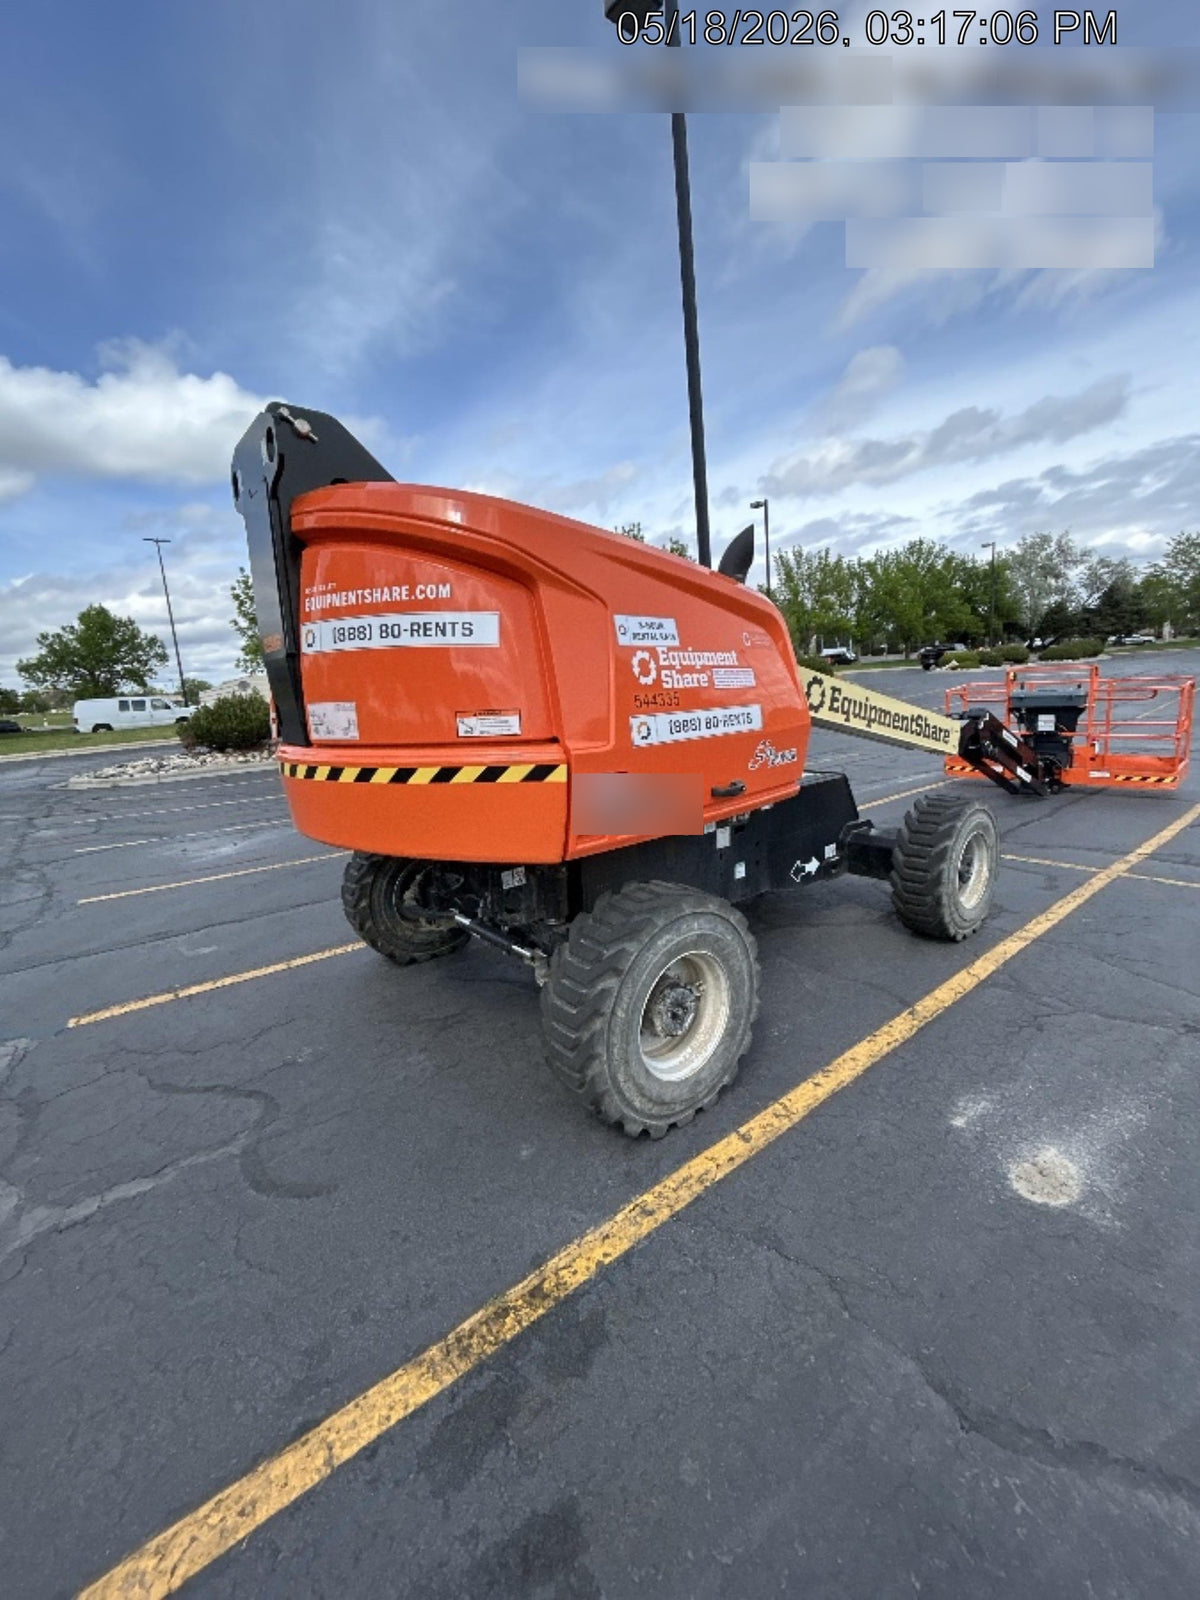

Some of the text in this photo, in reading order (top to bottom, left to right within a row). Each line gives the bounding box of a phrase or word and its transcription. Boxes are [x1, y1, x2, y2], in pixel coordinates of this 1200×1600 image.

[656, 646, 738, 669] Equipment
[660, 669, 709, 689] Share
[828, 685, 951, 745] EquipmentShare
